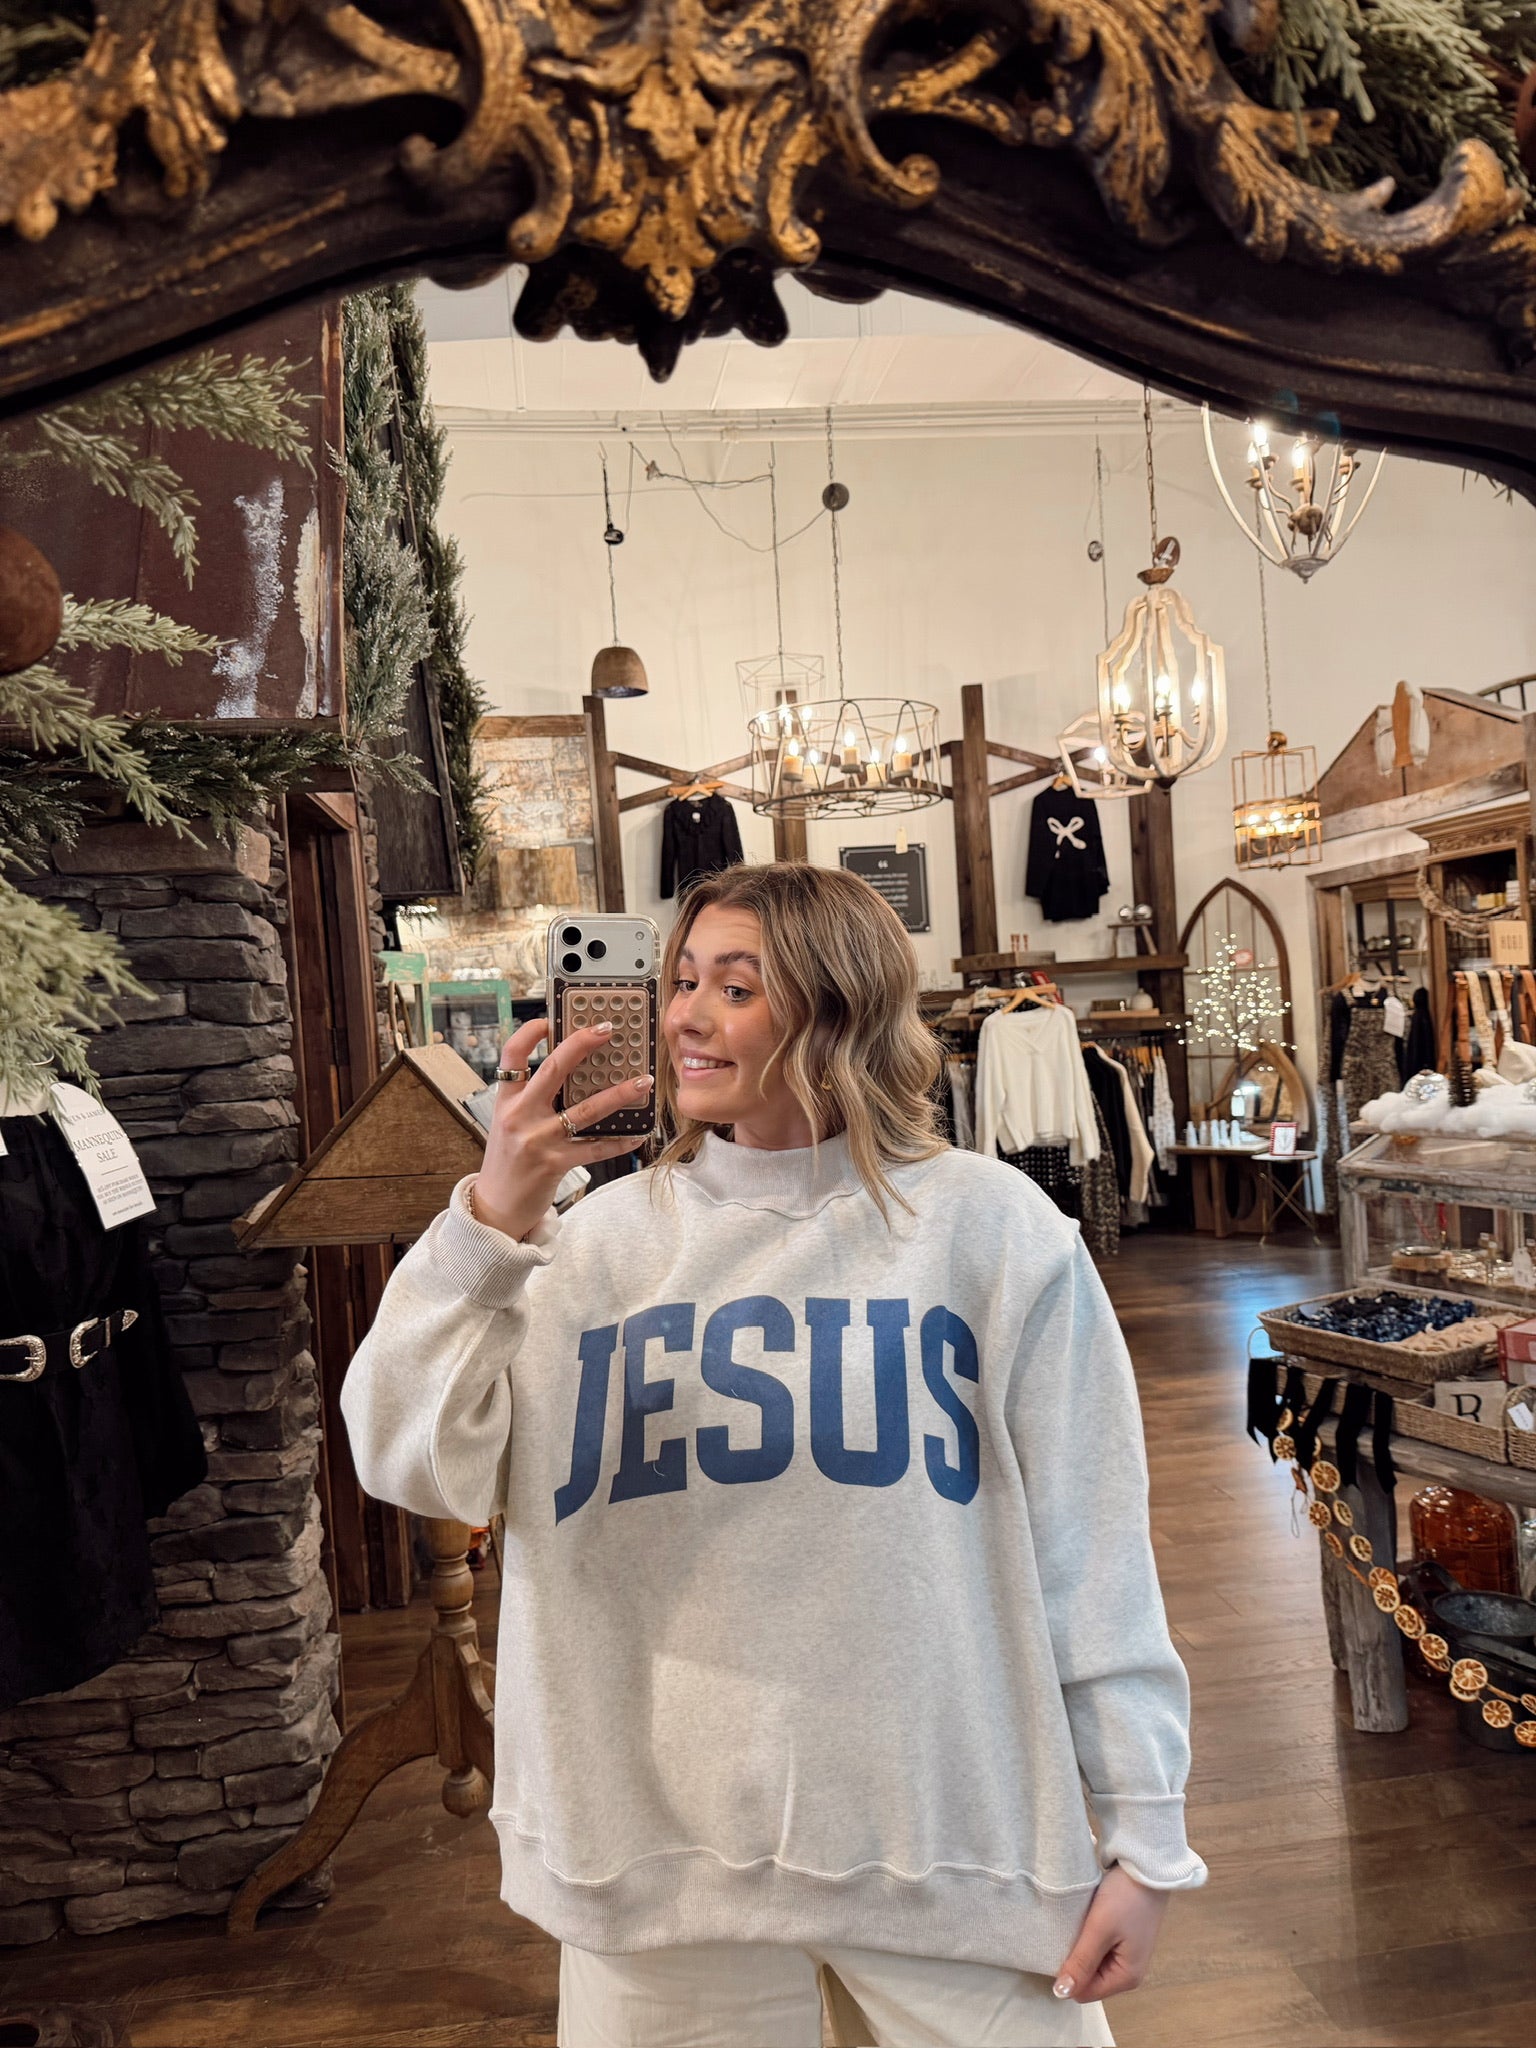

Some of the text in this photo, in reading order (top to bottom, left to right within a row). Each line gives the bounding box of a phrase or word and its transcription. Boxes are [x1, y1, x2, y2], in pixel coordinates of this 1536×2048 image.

[73, 1128, 124, 1152] MANNEQUIN
[96, 1149, 118, 1162] SALE
[554, 1295, 980, 1527] JESUS
[1451, 1393, 1482, 1422] R
